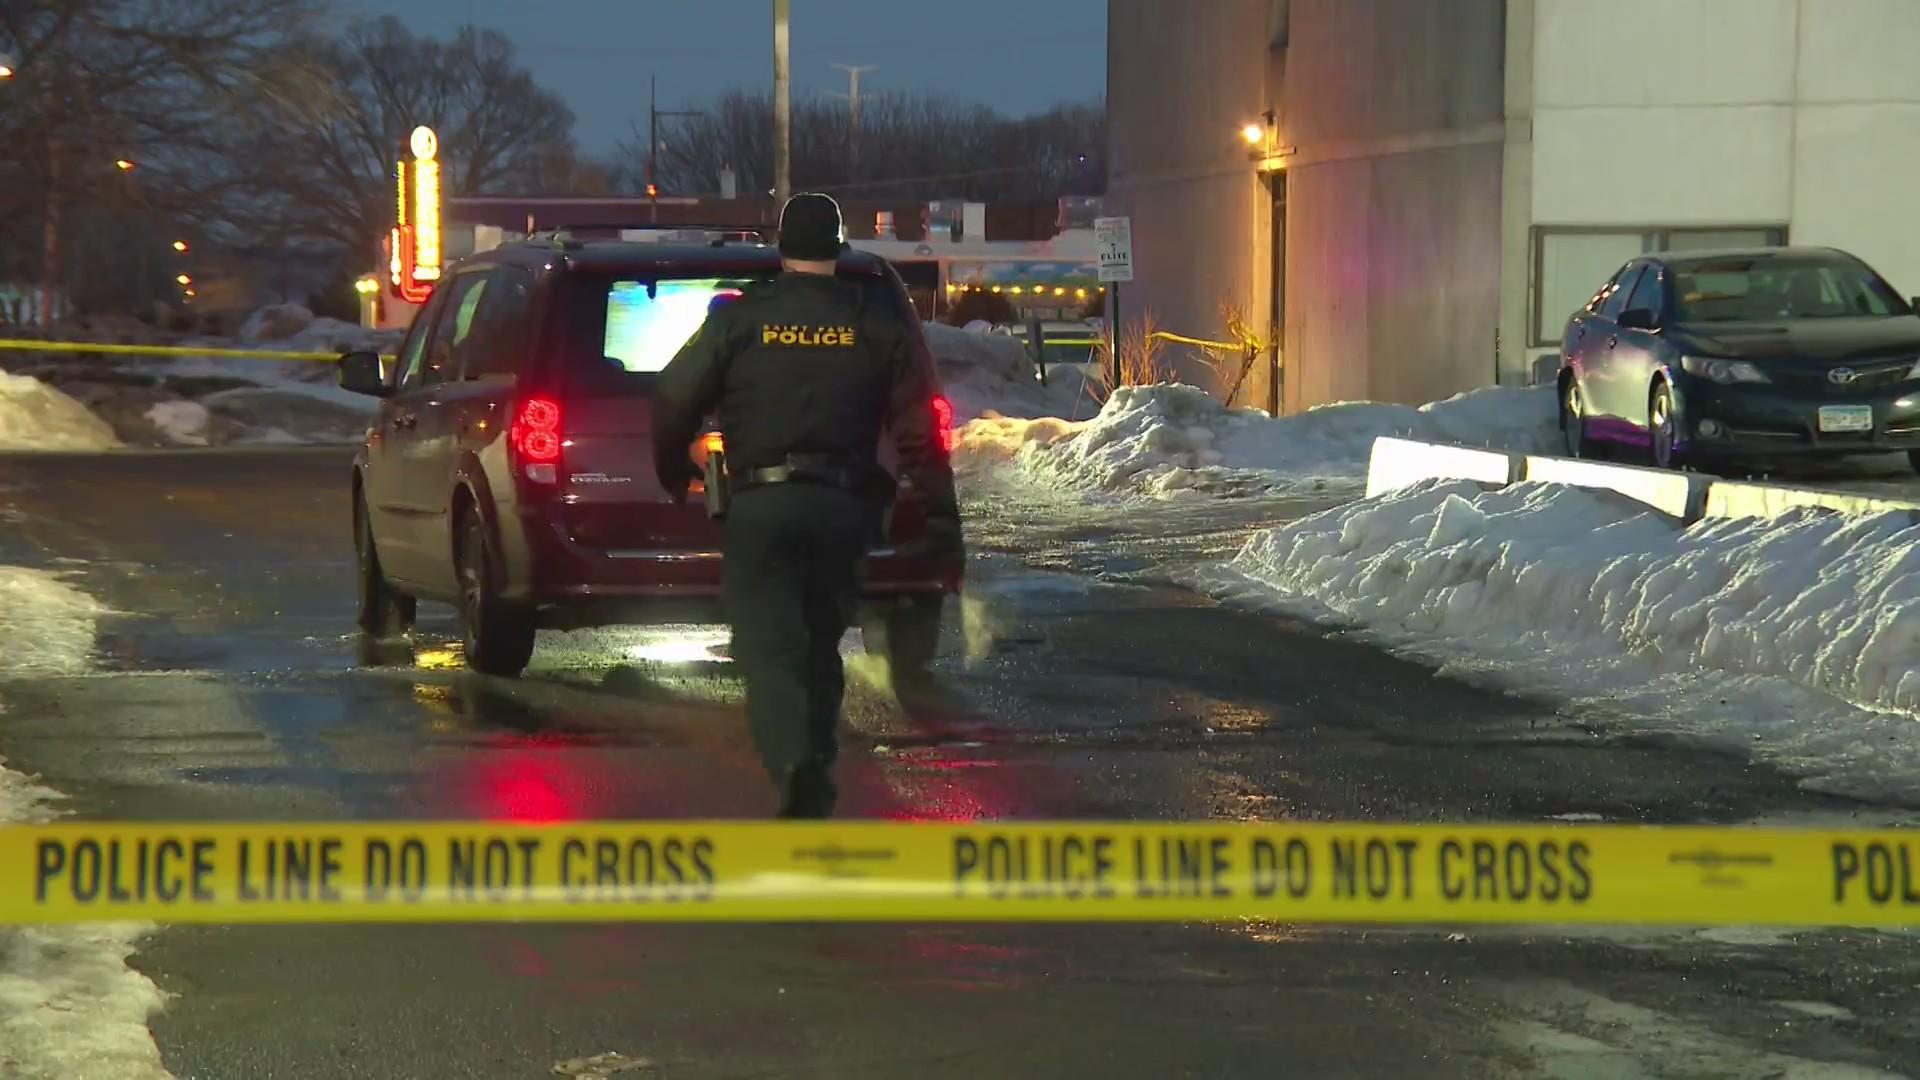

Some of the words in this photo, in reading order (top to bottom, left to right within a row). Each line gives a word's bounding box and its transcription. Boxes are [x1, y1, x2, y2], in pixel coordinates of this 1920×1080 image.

[762, 330, 855, 345] POLICE
[36, 838, 217, 903] POLICE
[238, 838, 342, 902] LINE
[365, 838, 428, 902] DO
[449, 838, 541, 902] NOT
[561, 838, 715, 902] CROSS
[954, 836, 1115, 900] POLICE
[1134, 837, 1231, 899] LINE
[1252, 837, 1311, 899] DO
[1331, 838, 1418, 900] NOT
[1438, 839, 1591, 902] CROSS
